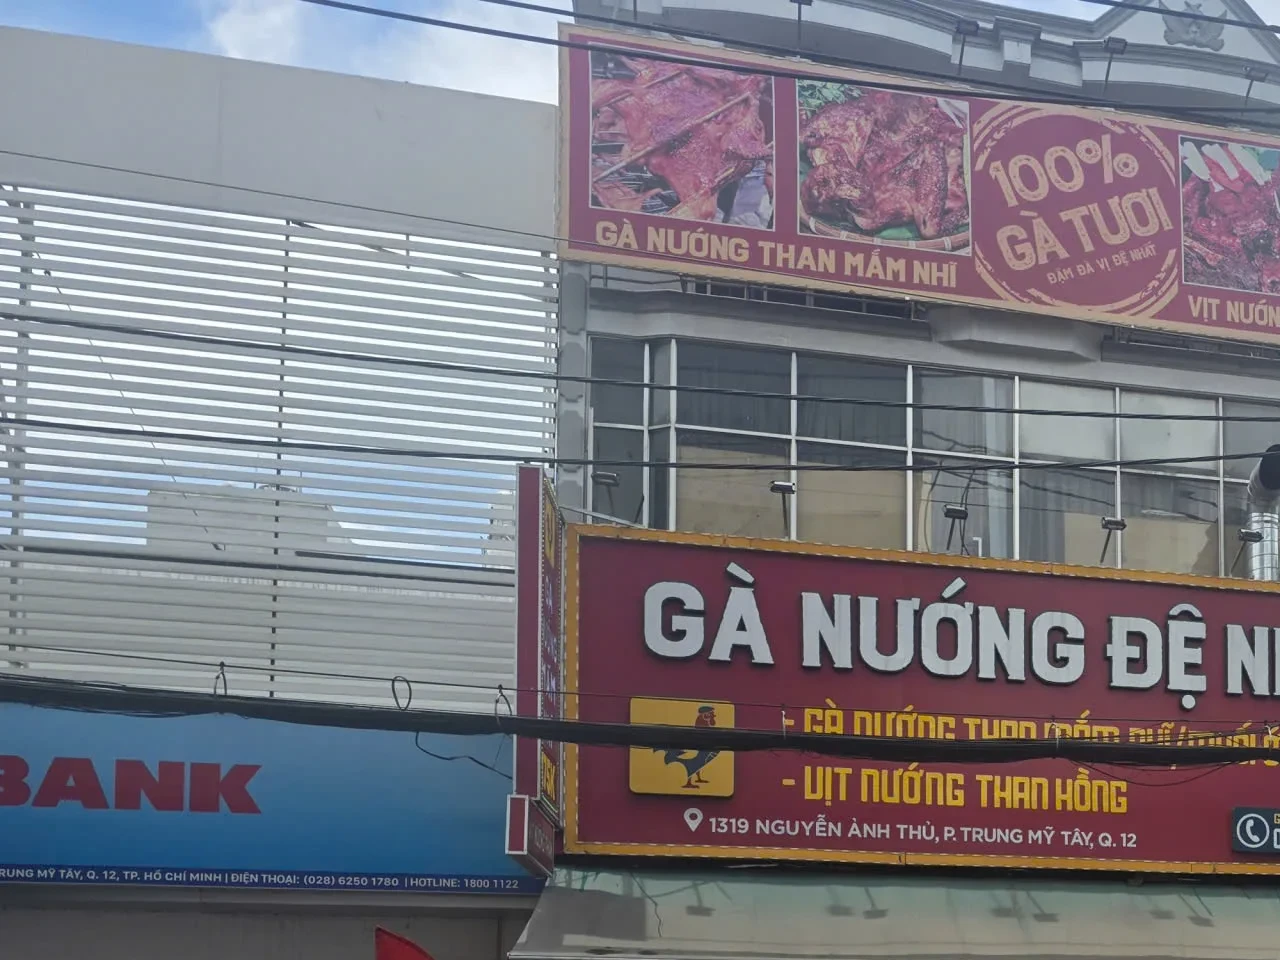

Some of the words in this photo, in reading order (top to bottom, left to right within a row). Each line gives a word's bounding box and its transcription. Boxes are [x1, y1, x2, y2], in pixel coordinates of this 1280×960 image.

[988, 133, 1139, 208] 100%
[595, 219, 638, 250] GÀ
[647, 226, 750, 263] NƯỚNG
[758, 240, 836, 274] THAN
[912, 259, 958, 288] NHĨ
[996, 210, 1070, 270] GÀ
[1058, 187, 1174, 252] TƯƠI
[1188, 295, 1220, 322] VỊT
[643, 564, 774, 664] GÀ
[801, 577, 1085, 684] NƯỚNG
[1107, 603, 1208, 709] ĐỆ
[860, 762, 965, 806] NƯỚNG
[976, 773, 1049, 811] THAN
[1055, 767, 1128, 813] HỒNG
[709, 817, 750, 835] 1319
[756, 814, 843, 838] NGUYỄN
[896, 821, 940, 844] THỦ,
[944, 826, 957, 841] P.
[960, 826, 1024, 844] TRUNG
[1028, 823, 1055, 846] MỸ
[1061, 828, 1095, 850] TÂY,
[1098, 832, 1117, 848] Q.
[1121, 832, 1138, 848] 12
[37, 868, 56, 879] MỸ
[59, 868, 84, 881] TÂY,
[86, 870, 99, 880] Q.
[102, 870, 120, 882] 12,
[123, 871, 141, 881] TP.
[165, 870, 187, 882] CHÍ
[189, 873, 222, 883] MINH
[231, 872, 259, 885] ĐIỆN
[303, 875, 336, 886] (028)
[338, 876, 368, 886] 6250
[372, 877, 399, 887] 1780
[410, 877, 461, 888] HOTLINE:
[464, 879, 490, 888] 1800
[493, 879, 519, 889] 1122
